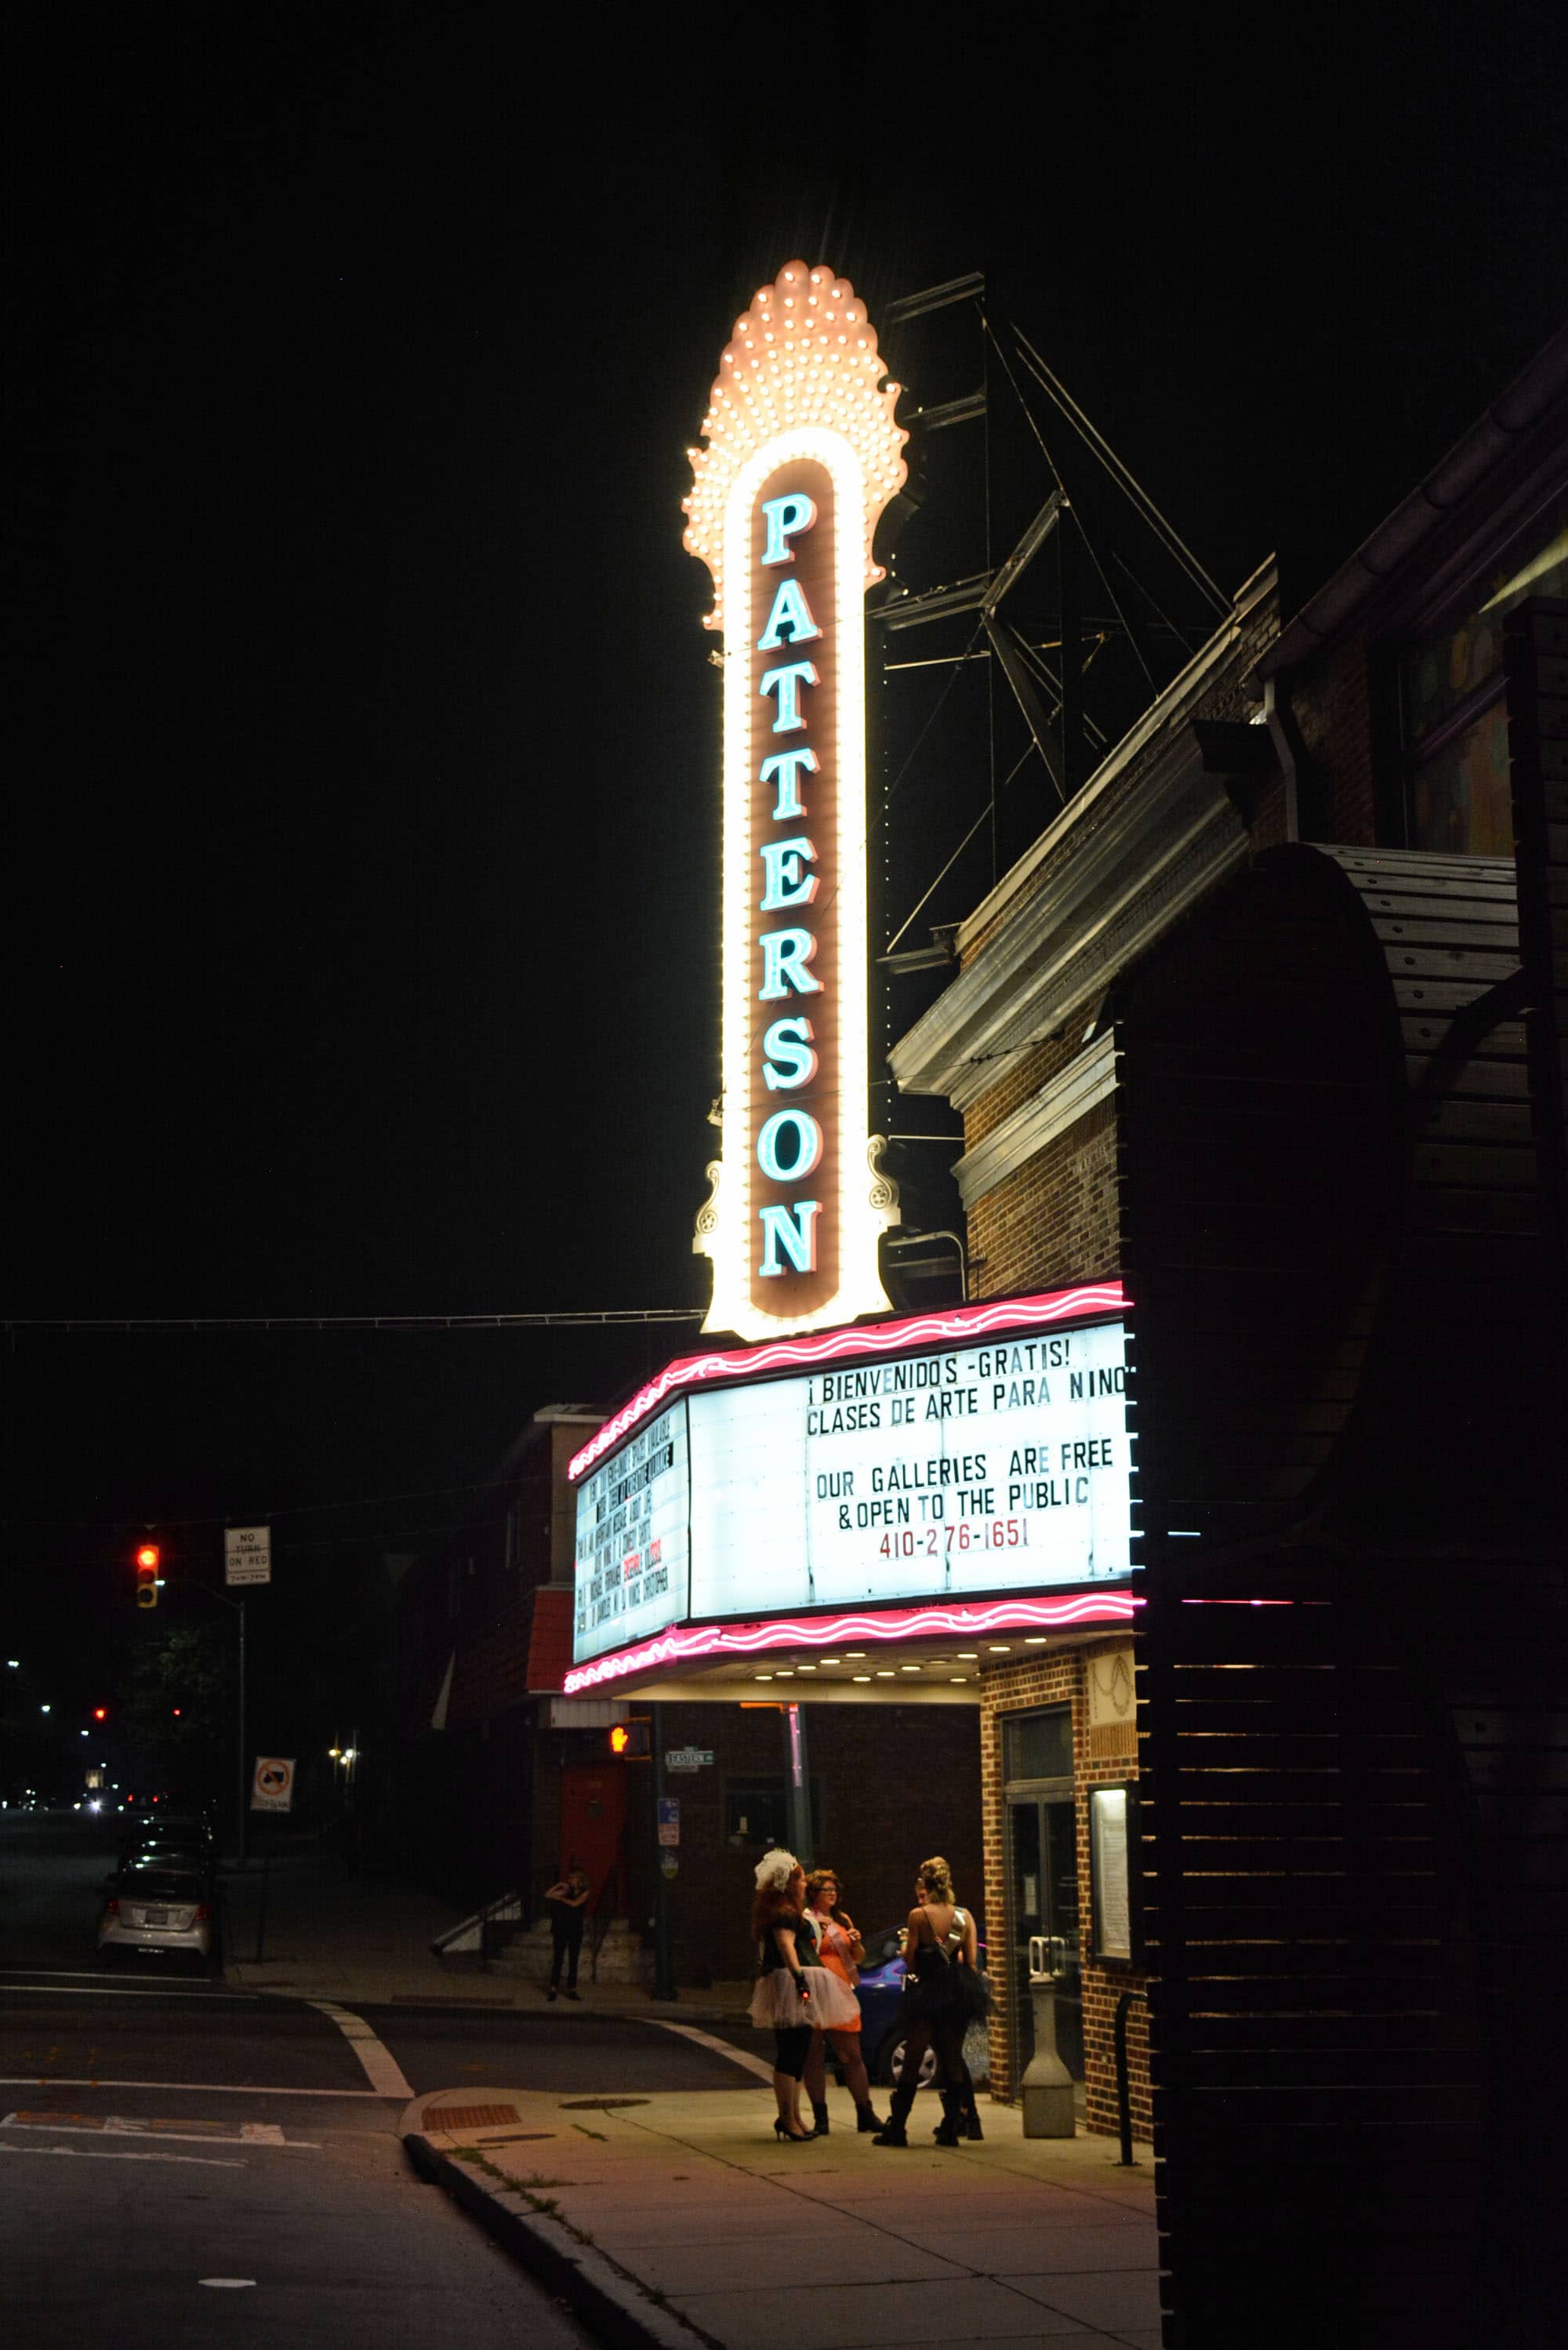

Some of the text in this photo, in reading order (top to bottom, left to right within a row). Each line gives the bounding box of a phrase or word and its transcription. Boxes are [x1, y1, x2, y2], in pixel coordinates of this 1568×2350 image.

[757, 492, 823, 1278] PATTERSON
[808, 1402, 880, 1436] CLASES
[892, 1397, 915, 1425] DE
[926, 1387, 978, 1421] ARTE
[993, 1377, 1051, 1410] PARA
[817, 1438, 1113, 1498] OUR GALLERIES ARE FREE
[917, 1494, 943, 1520] TO
[957, 1487, 994, 1517] THE
[1009, 1476, 1088, 1512] PUBLIC
[229, 1556, 267, 1567] ON RED
[240, 1533, 255, 1542] NO
